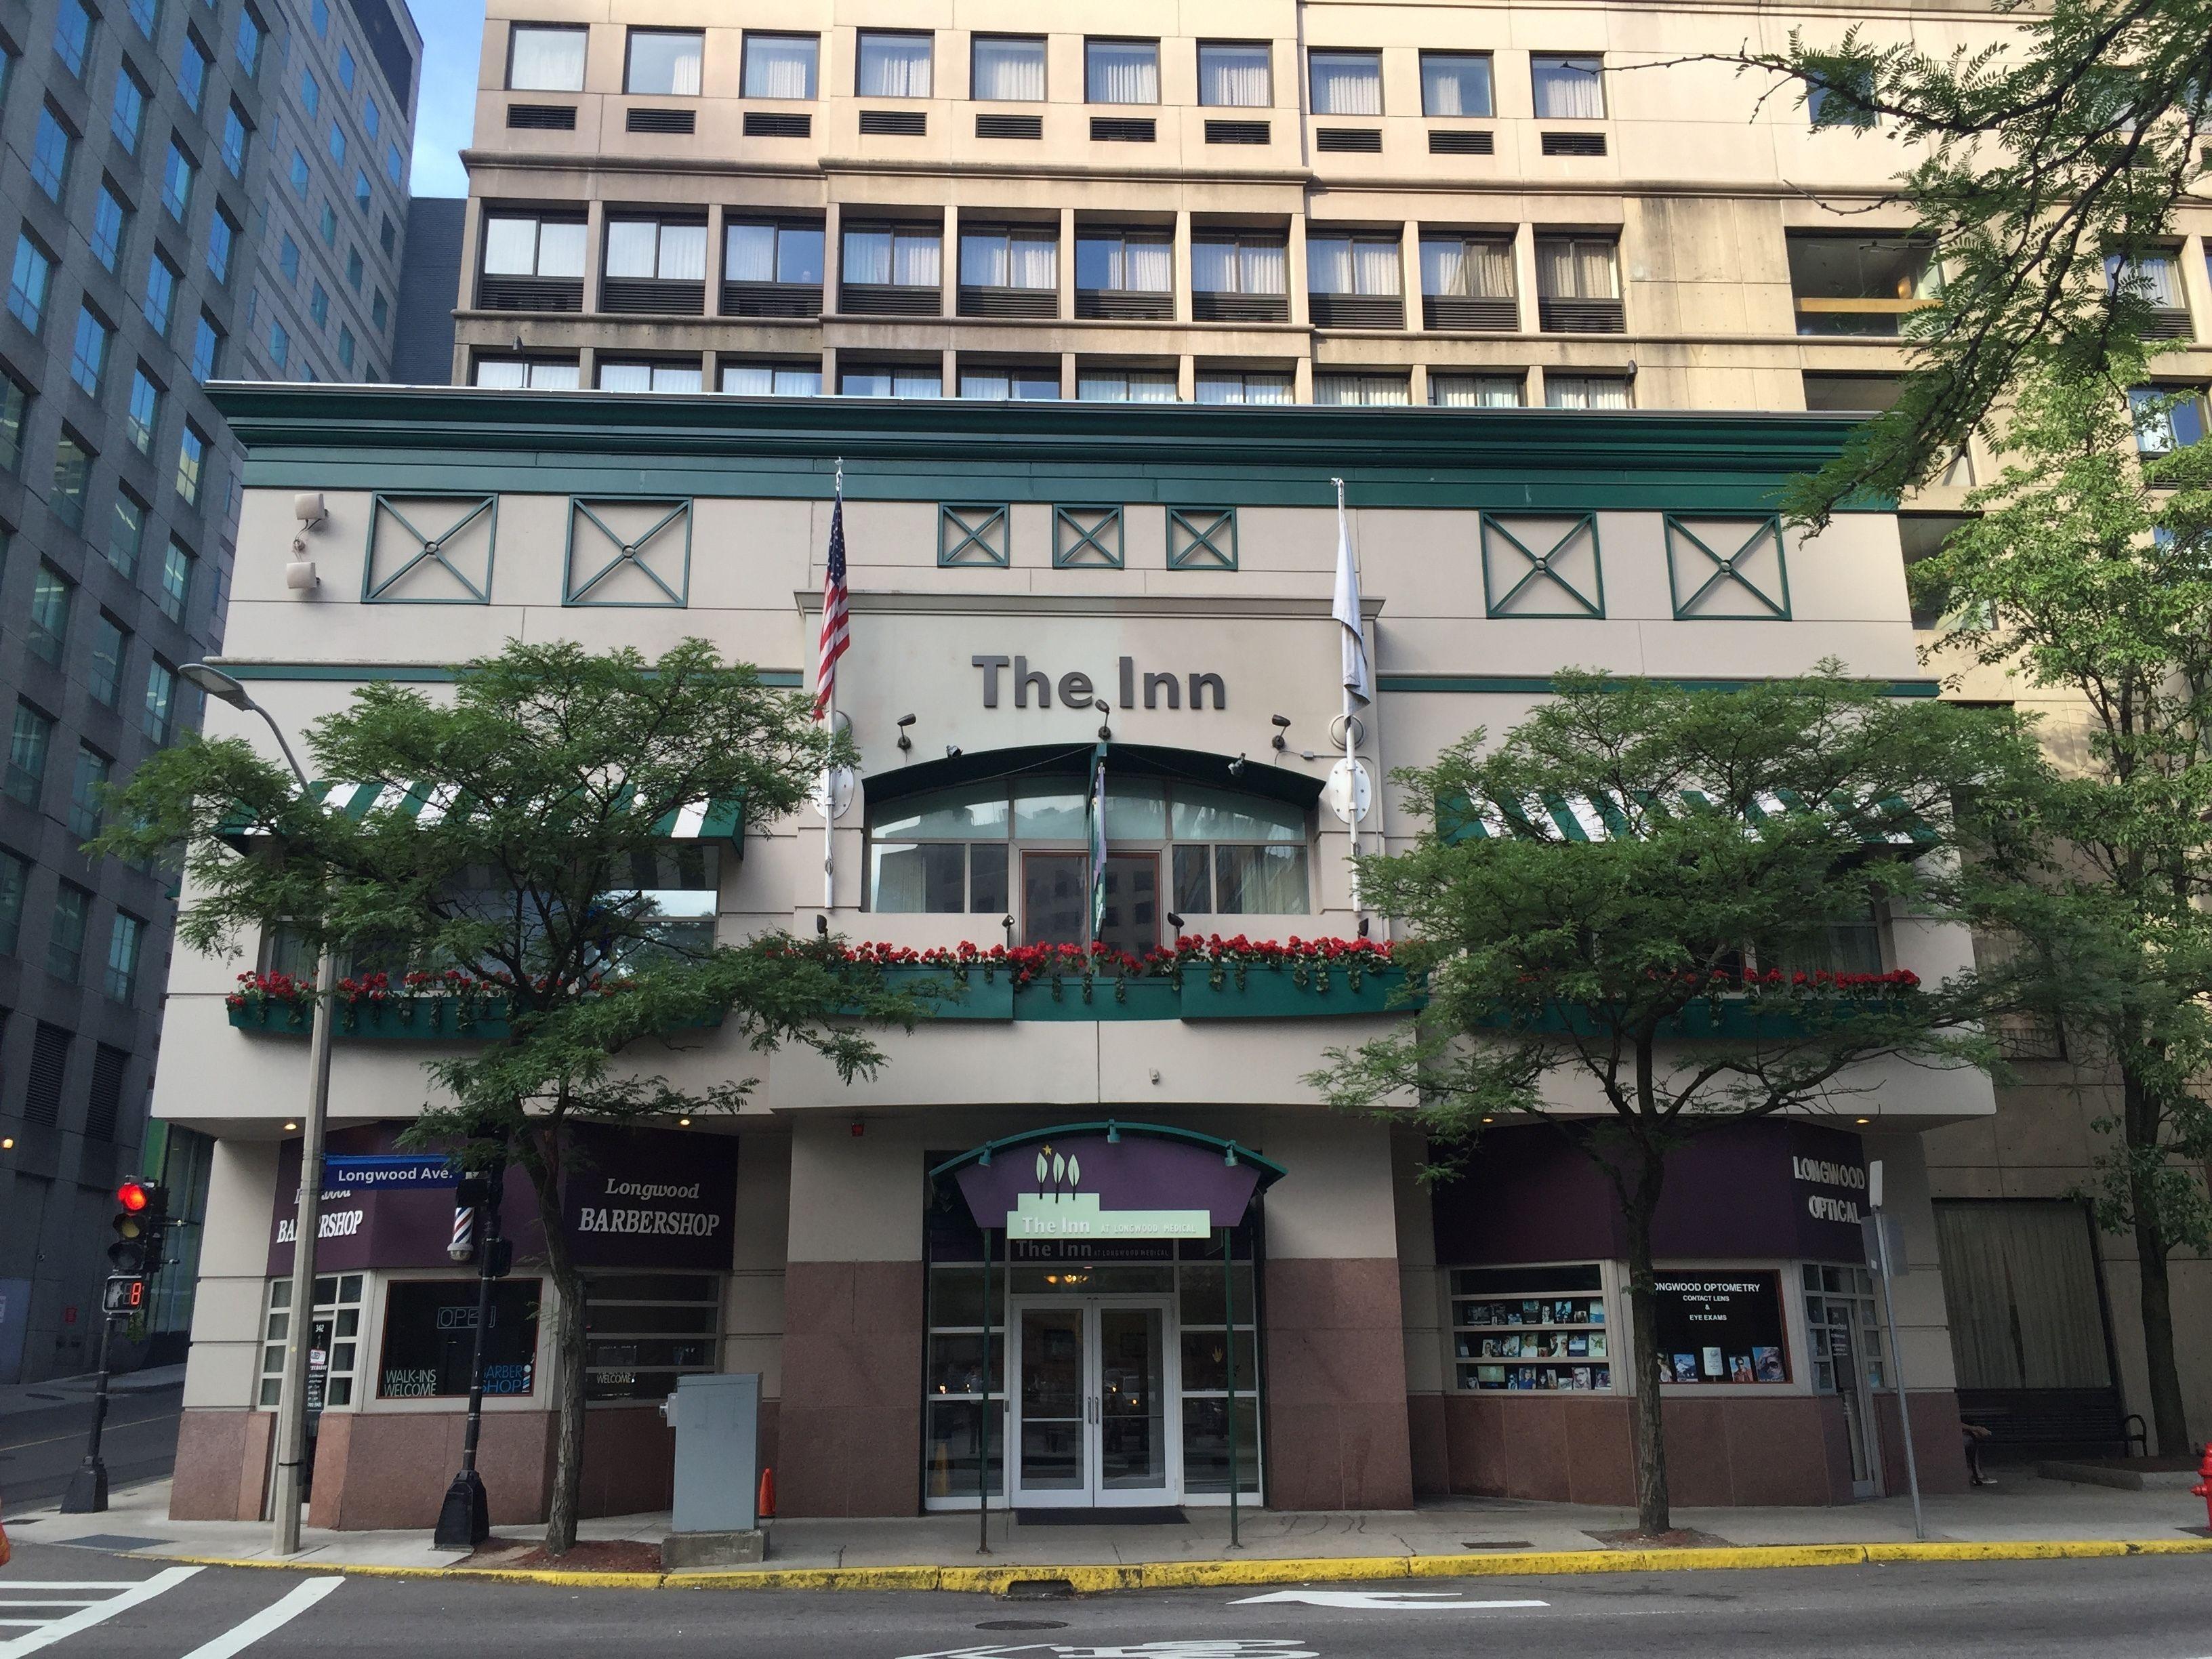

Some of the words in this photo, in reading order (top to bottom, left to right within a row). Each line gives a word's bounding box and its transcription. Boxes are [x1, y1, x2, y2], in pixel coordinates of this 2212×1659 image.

[972, 655, 1093, 709] The
[1119, 656, 1225, 710] Inn
[338, 1168, 417, 1184] Longwood
[421, 1167, 453, 1179] Ave.
[1793, 1155, 1865, 1189] LONGWOOD
[605, 1179, 700, 1201] Longwood
[1808, 1195, 1862, 1224] OPTICAL
[276, 1210, 363, 1244] BARSHOP
[577, 1208, 720, 1236] BARBERSHOP
[1022, 1216, 1057, 1234] The
[1062, 1216, 1090, 1233] Inn
[1101, 1225, 1109, 1233] AT
[1114, 1224, 1158, 1233] LONGWOOD
[1163, 1223, 1196, 1233] MEDICAL
[1017, 1240, 1052, 1257] The
[1059, 1240, 1092, 1257] Inn
[1654, 1282, 1702, 1292] NGWOOD
[1703, 1283, 1760, 1292] OPTOMETRY
[440, 1308, 496, 1326] OPE
[315, 1324, 325, 1333] 342
[386, 1369, 436, 1384] WALK-INS
[482, 1365, 523, 1378] ARBER
[597, 1374, 632, 1384] WELCOME
[384, 1383, 436, 1397] WELCOME
